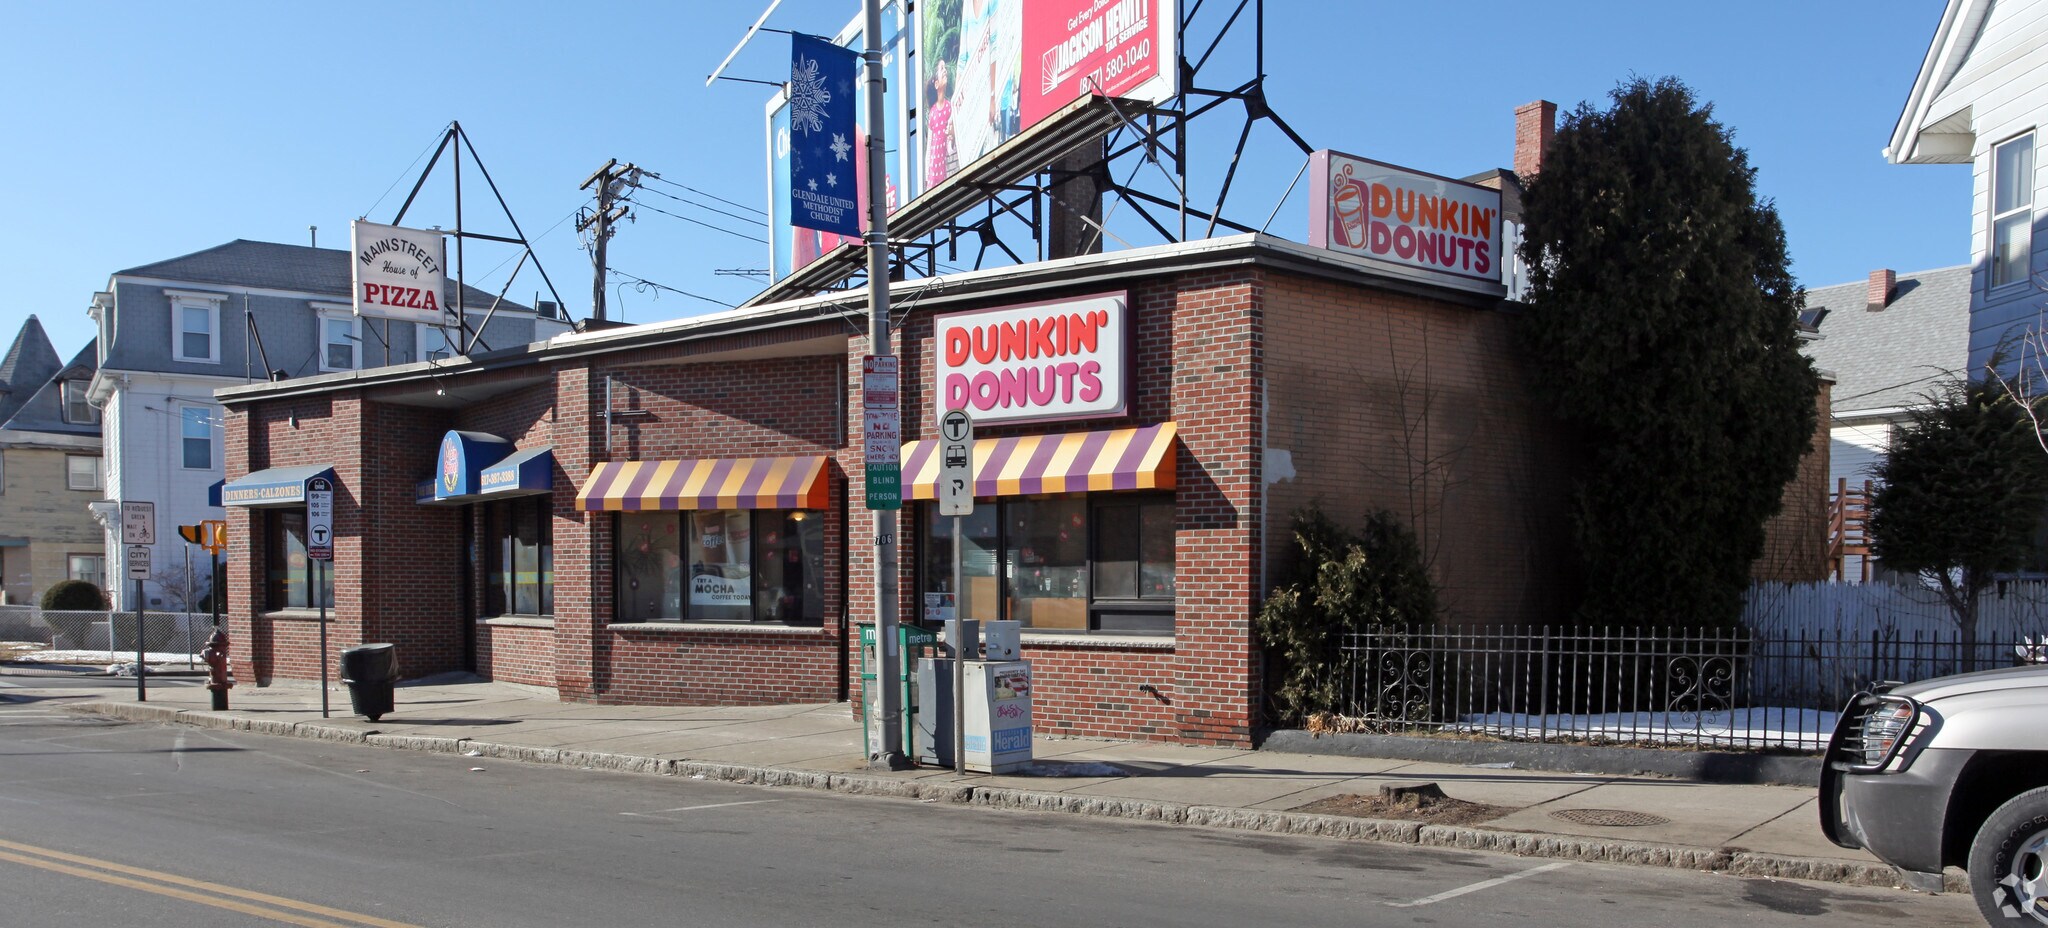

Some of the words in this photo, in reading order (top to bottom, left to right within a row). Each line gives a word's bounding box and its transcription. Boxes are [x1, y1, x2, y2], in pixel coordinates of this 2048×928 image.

[1058, 16, 1104, 74] JACKSON
[1105, 37, 1118, 53] TAX
[1119, 17, 1148, 45] SERVICE
[1105, 38, 1150, 81] 580-1040
[792, 188, 829, 205] GLENDALE
[830, 196, 854, 210] UNITED
[803, 201, 843, 217] METHODIST
[810, 211, 840, 224] CHURCH
[1371, 182, 1496, 240] DUNKIN'
[360, 238, 440, 274] MAINSTREET
[1371, 221, 1490, 274] DONUTS
[383, 260, 406, 276] House
[410, 266, 420, 280] of
[363, 282, 439, 311] PIZZA
[945, 309, 1108, 368] DUNKIN'
[945, 360, 1102, 412] DONUTS
[866, 432, 897, 440] PARKING
[947, 418, 965, 437] T
[868, 464, 898, 472] CAUTION
[872, 477, 895, 485] BLIND
[314, 530, 327, 541] T
[695, 584, 734, 593] MOCHA
[994, 728, 1029, 751] Herald
